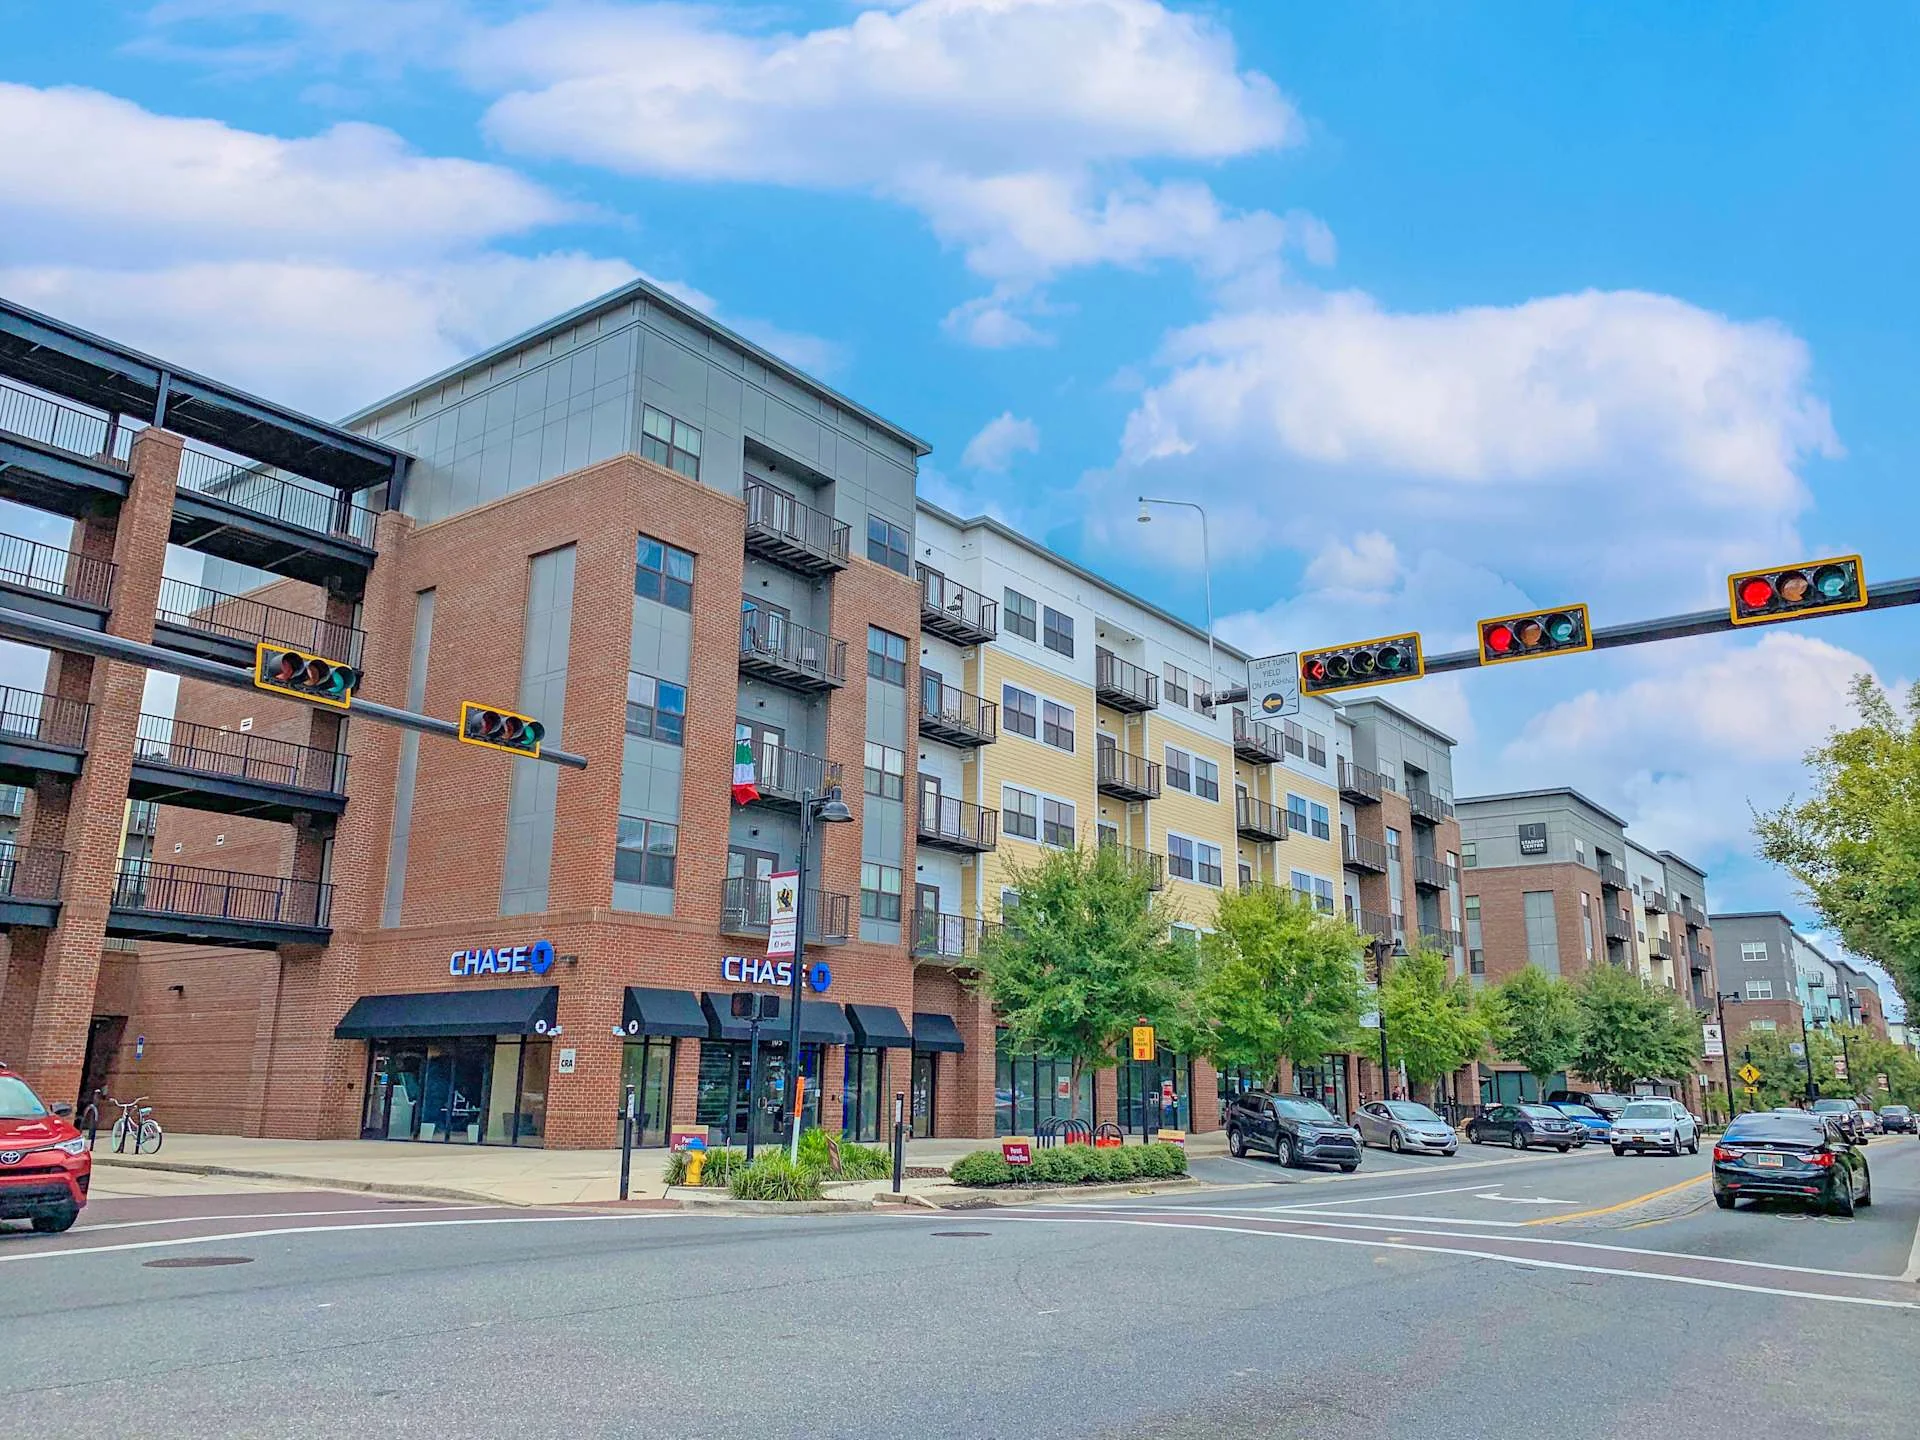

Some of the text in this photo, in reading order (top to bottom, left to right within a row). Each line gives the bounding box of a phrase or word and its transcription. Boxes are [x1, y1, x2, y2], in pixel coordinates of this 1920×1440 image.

[1255, 657, 1290, 669] LEFT TURN
[1262, 669, 1281, 677] YIELD
[1252, 676, 1295, 689] ON FLASHING
[449, 945, 529, 976] CHASE
[560, 1059, 573, 1067] CRA
